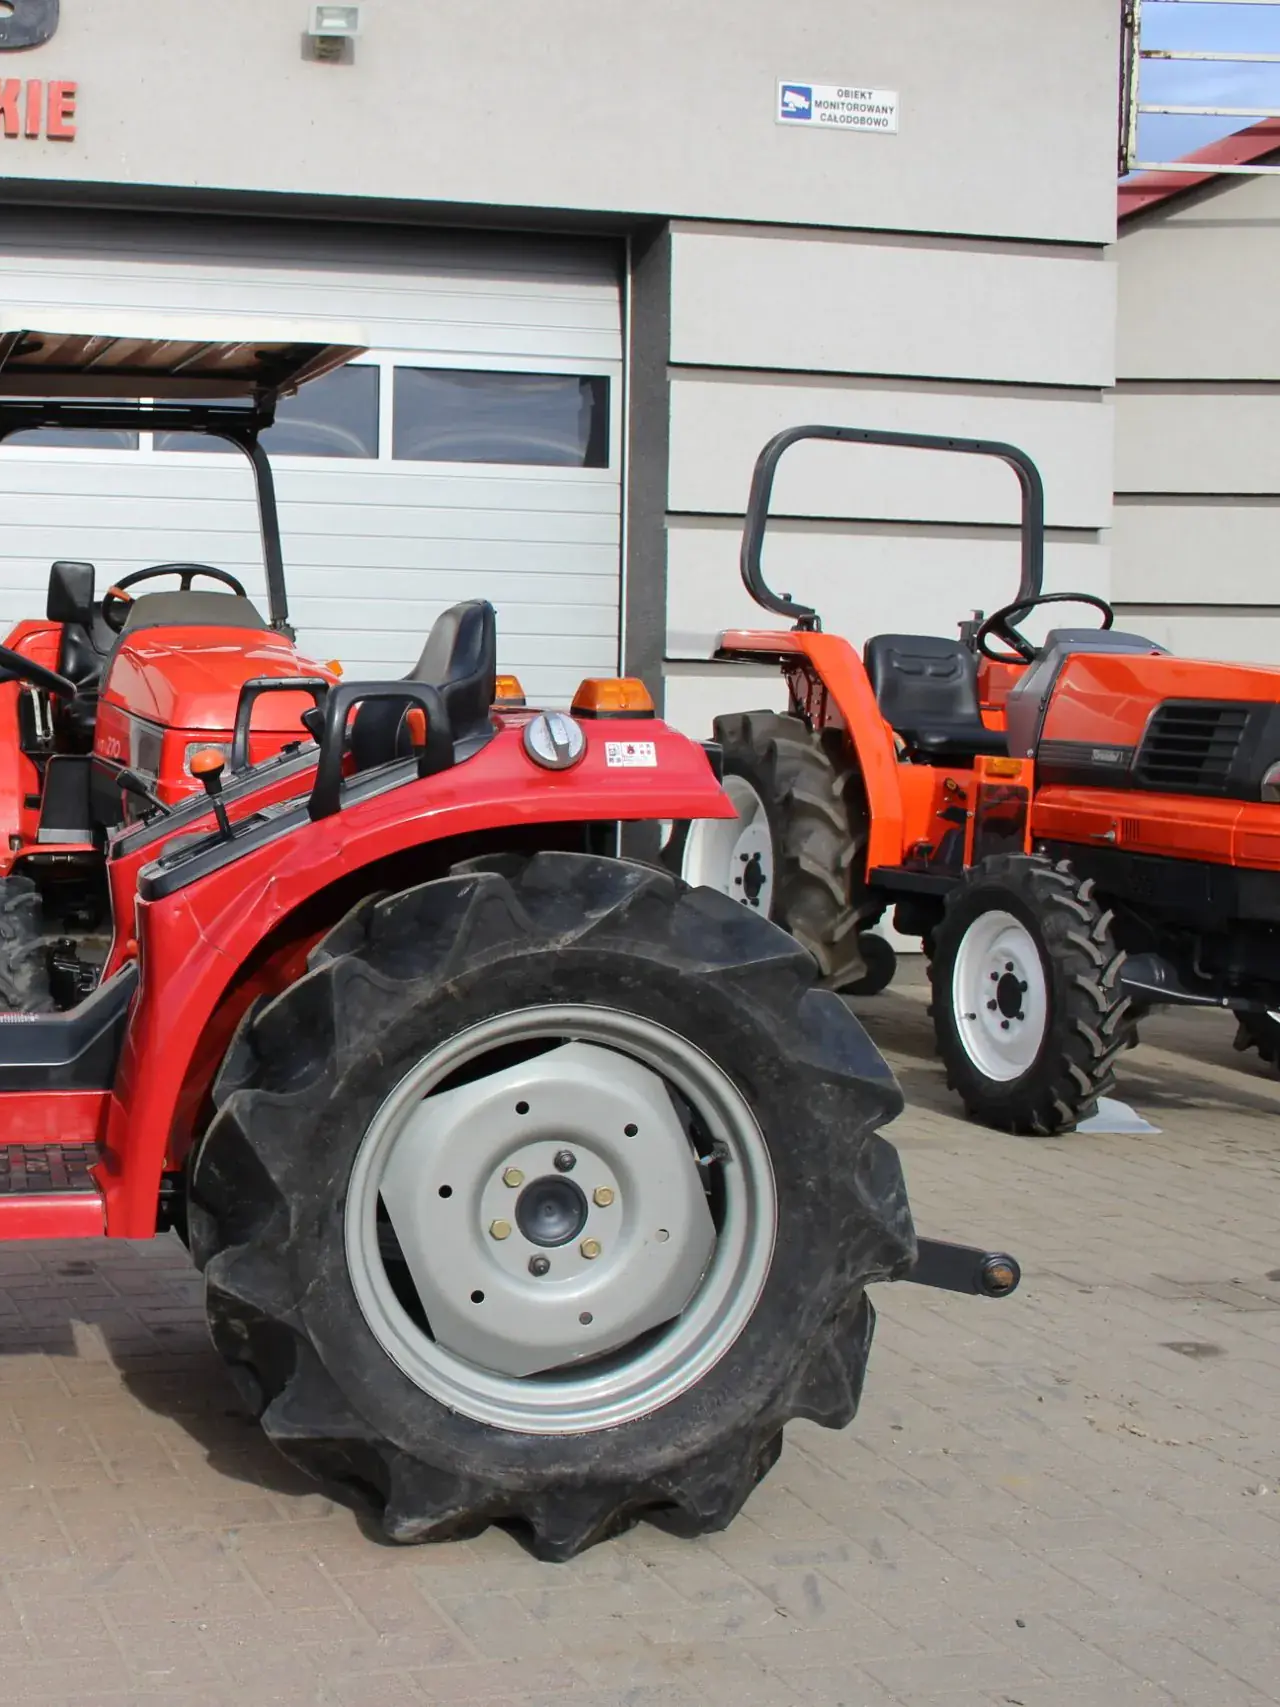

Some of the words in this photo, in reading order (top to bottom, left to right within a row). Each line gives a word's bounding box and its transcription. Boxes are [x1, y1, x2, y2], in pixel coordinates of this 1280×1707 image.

[837, 88, 874, 101] OBIEKT
[814, 100, 895, 115] MONITOROWANY
[820, 112, 889, 128] CAŁODOBOWO
